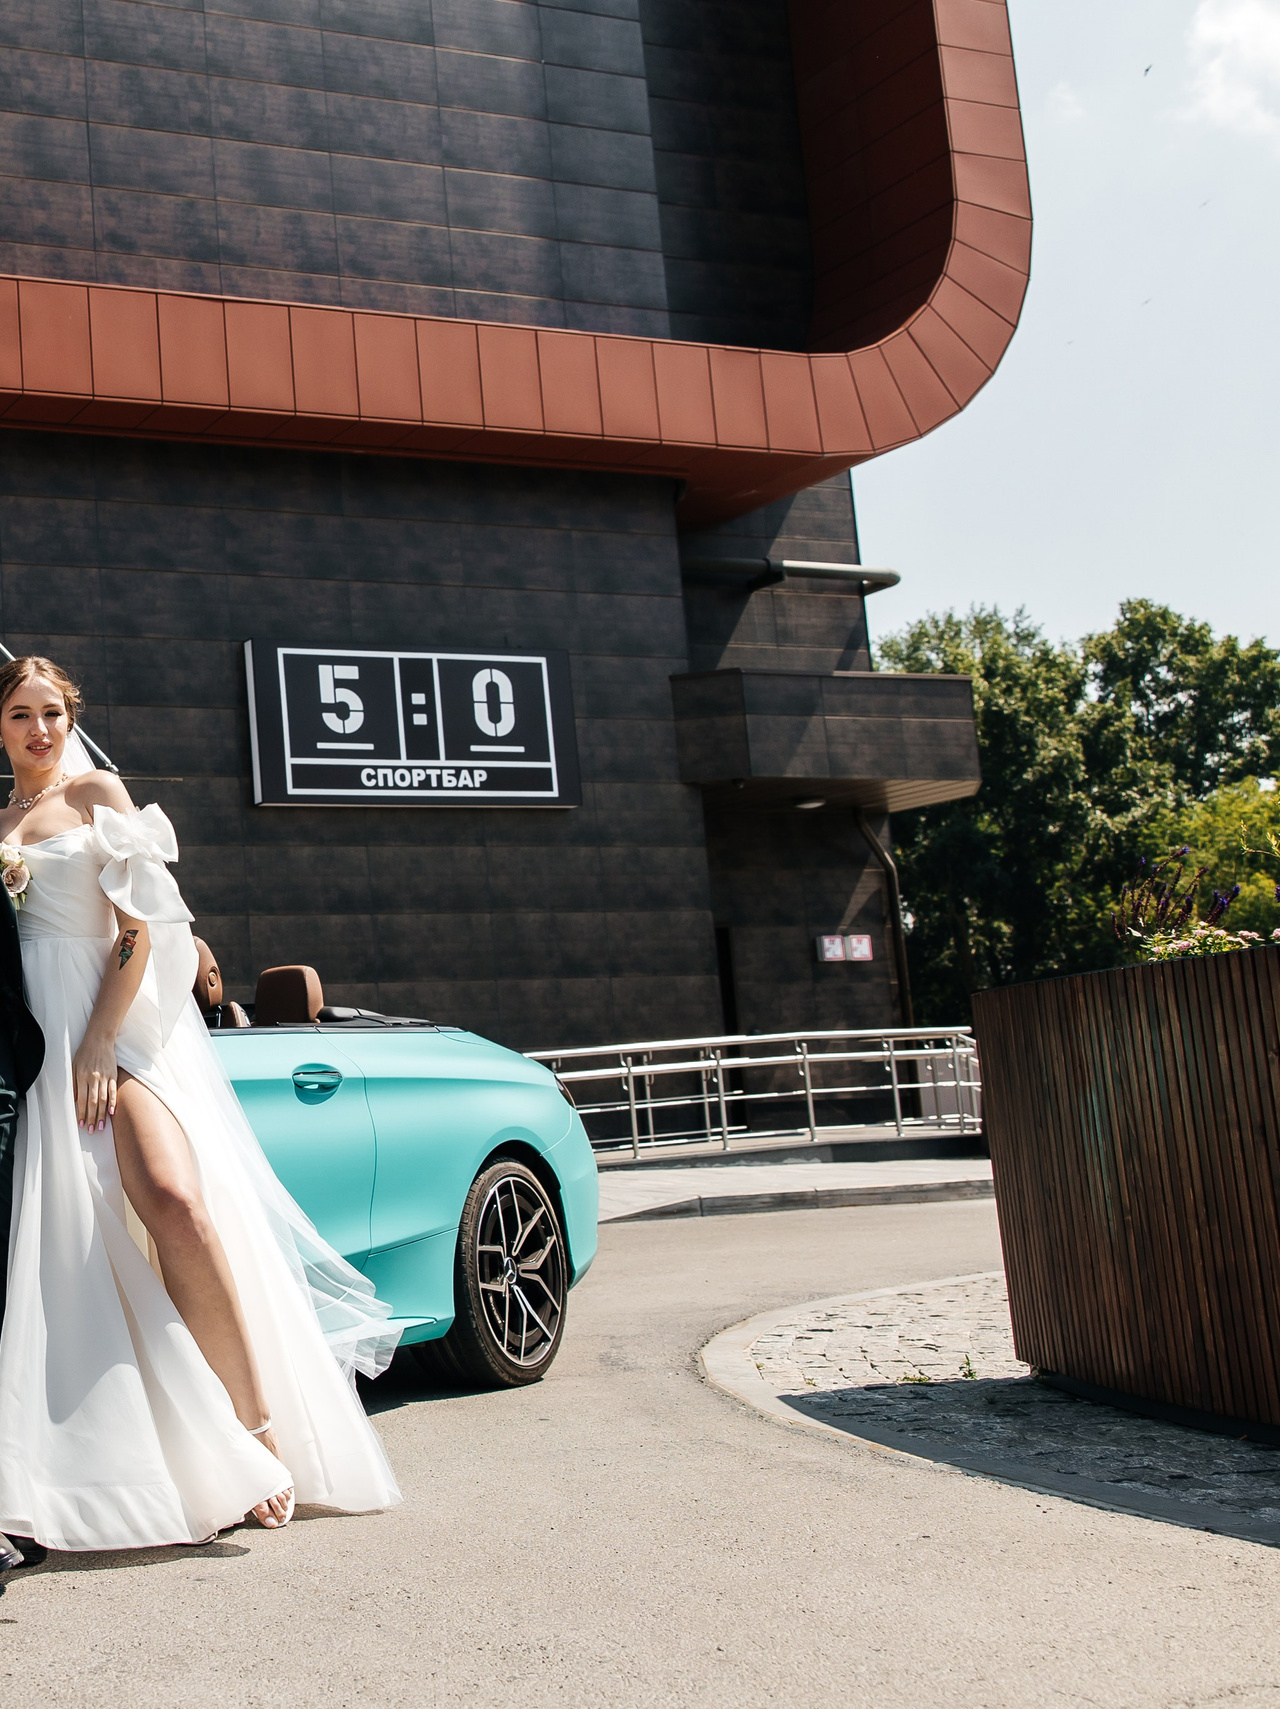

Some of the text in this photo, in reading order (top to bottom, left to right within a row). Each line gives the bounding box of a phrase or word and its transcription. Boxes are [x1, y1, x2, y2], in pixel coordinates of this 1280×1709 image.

[318, 665, 365, 734] 5
[472, 668, 516, 737] 0
[360, 767, 488, 788] СПОРТБАР
